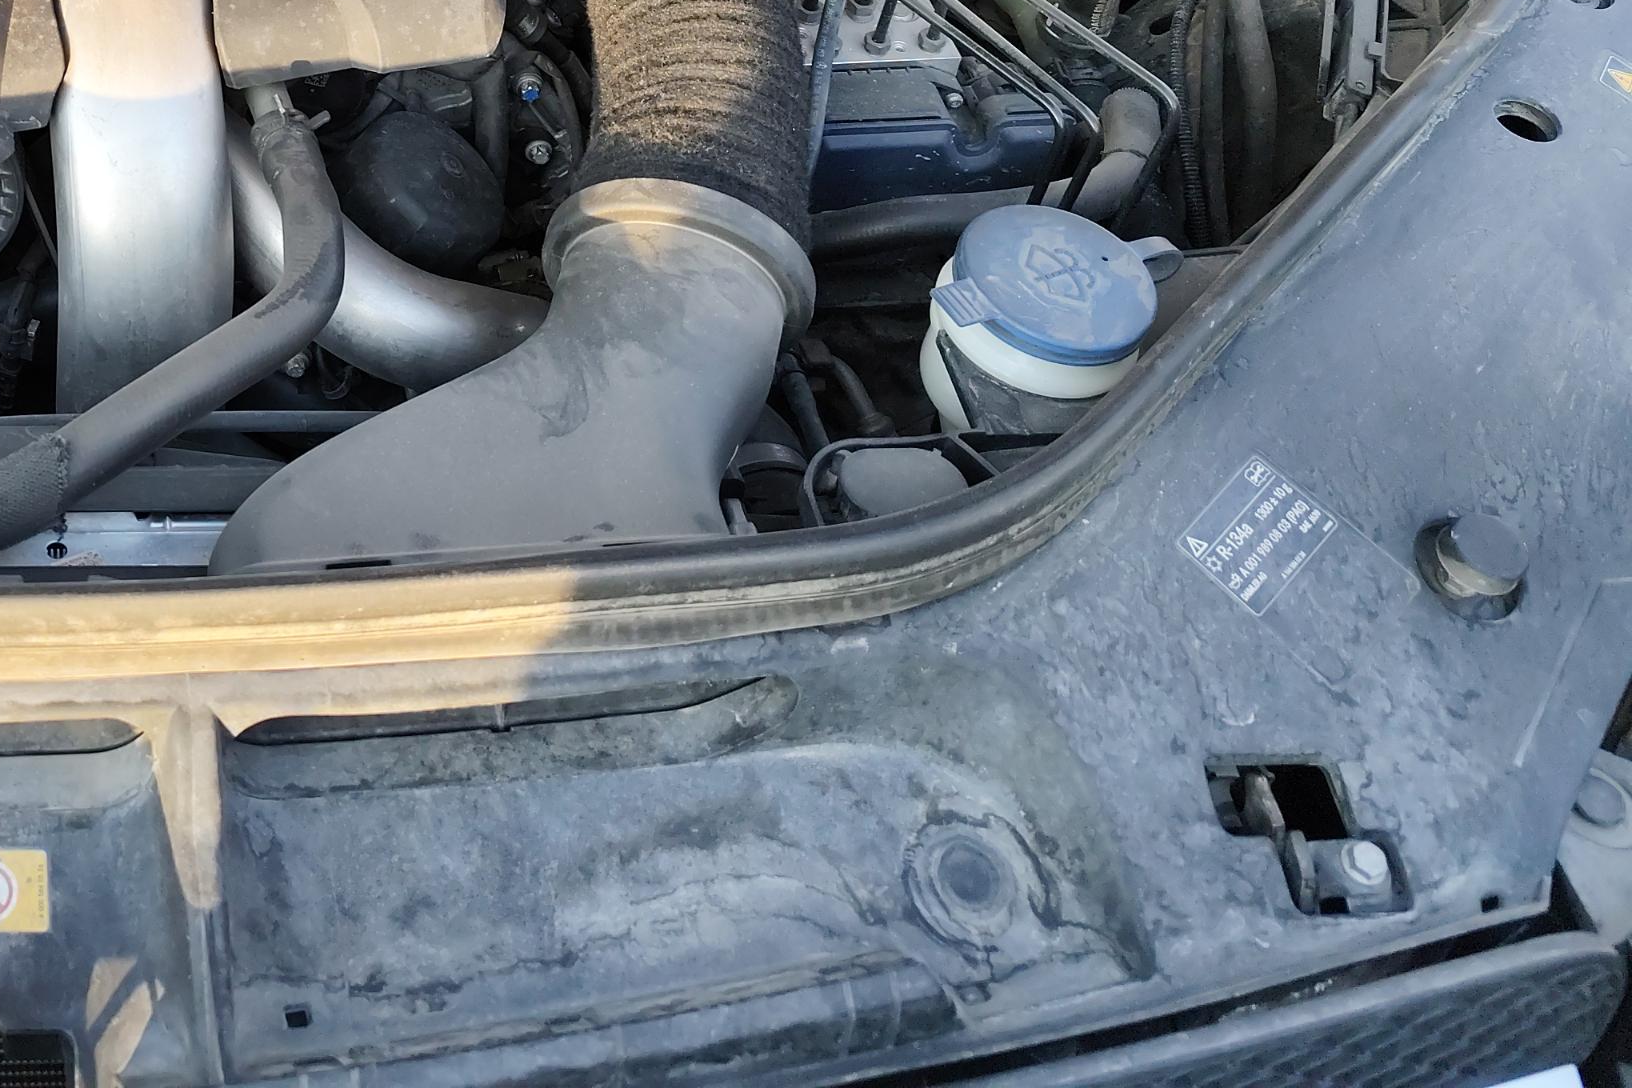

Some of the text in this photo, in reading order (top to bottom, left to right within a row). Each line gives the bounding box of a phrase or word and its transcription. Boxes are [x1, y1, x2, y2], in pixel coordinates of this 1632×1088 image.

[1216, 524, 1253, 560] R-134a
[1255, 502, 1273, 520] 1300
[1273, 487, 1286, 499] 10
[1239, 567, 1250, 577] A
[1245, 553, 1262, 570] 001
[1257, 539, 1273, 556] 989
[1278, 519, 1291, 532] 03
